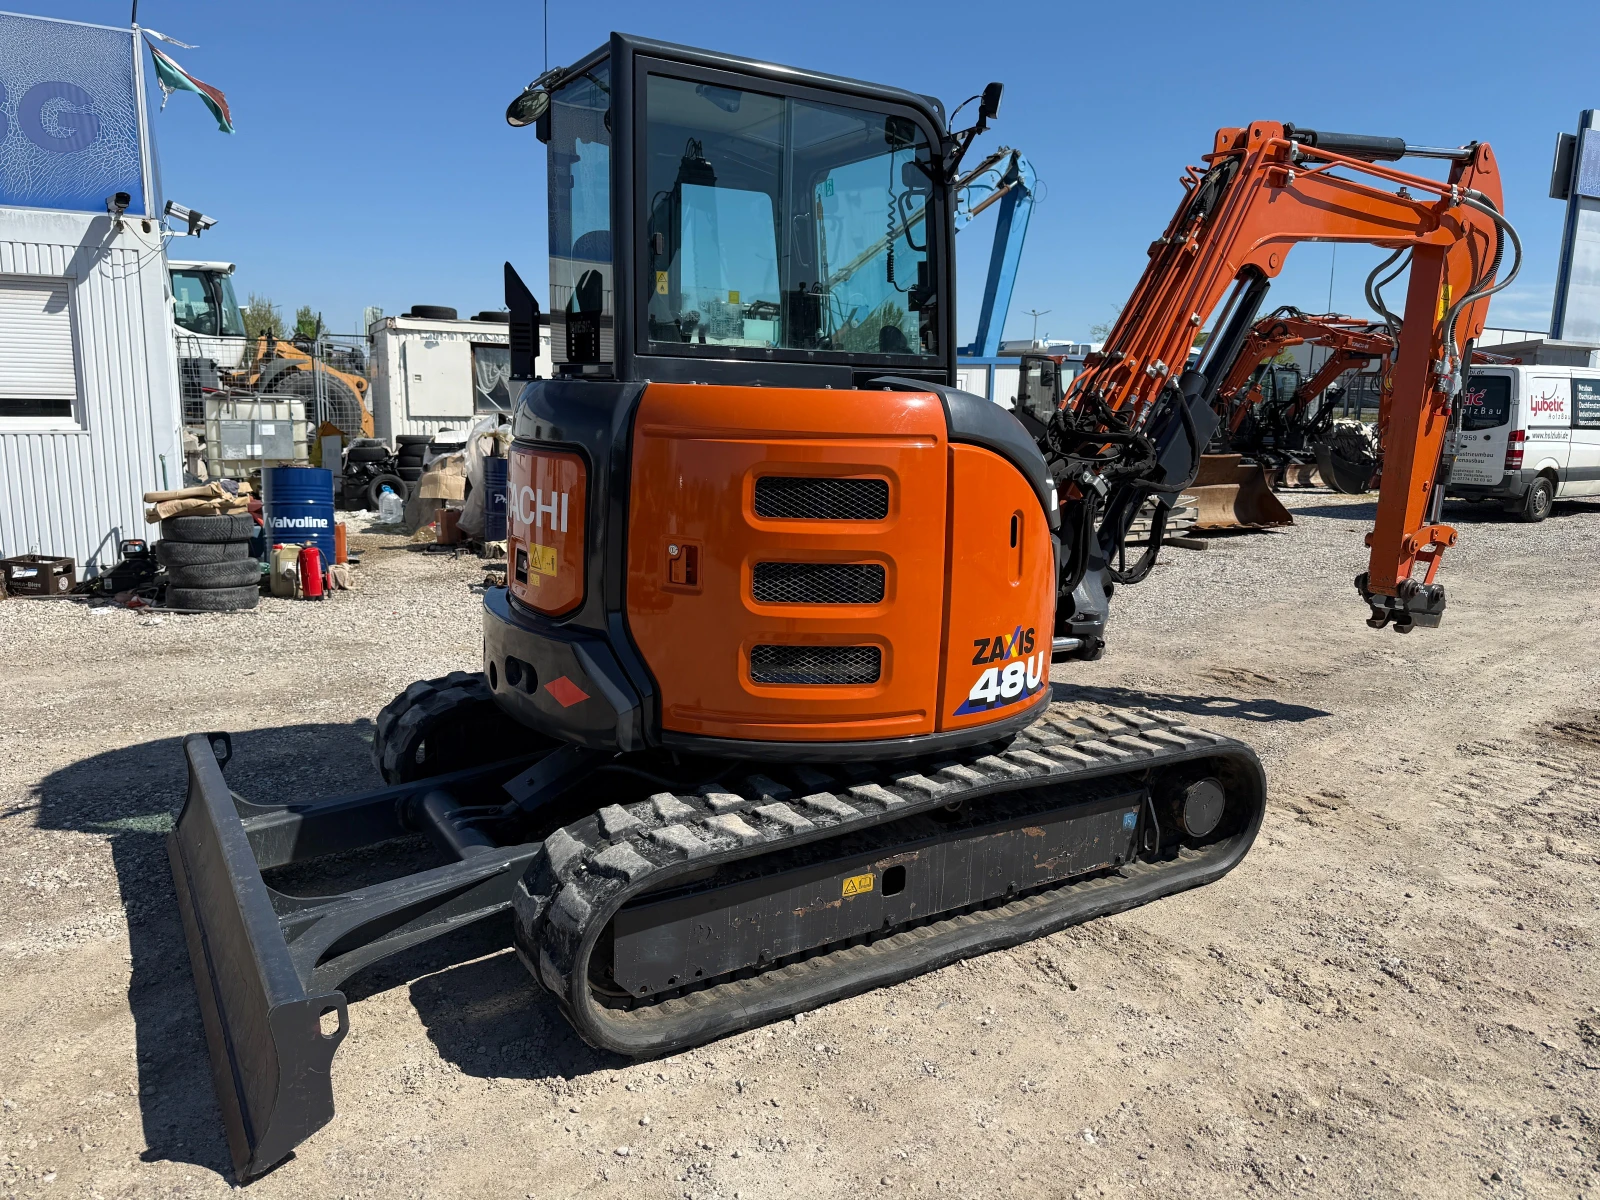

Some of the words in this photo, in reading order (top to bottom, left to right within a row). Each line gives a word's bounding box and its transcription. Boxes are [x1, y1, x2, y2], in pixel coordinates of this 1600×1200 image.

[1531, 390, 1564, 417] Ljubetić
[268, 516, 328, 528] Valvoline
[972, 625, 1035, 666] ZAXIS
[969, 651, 1044, 704] 48U
